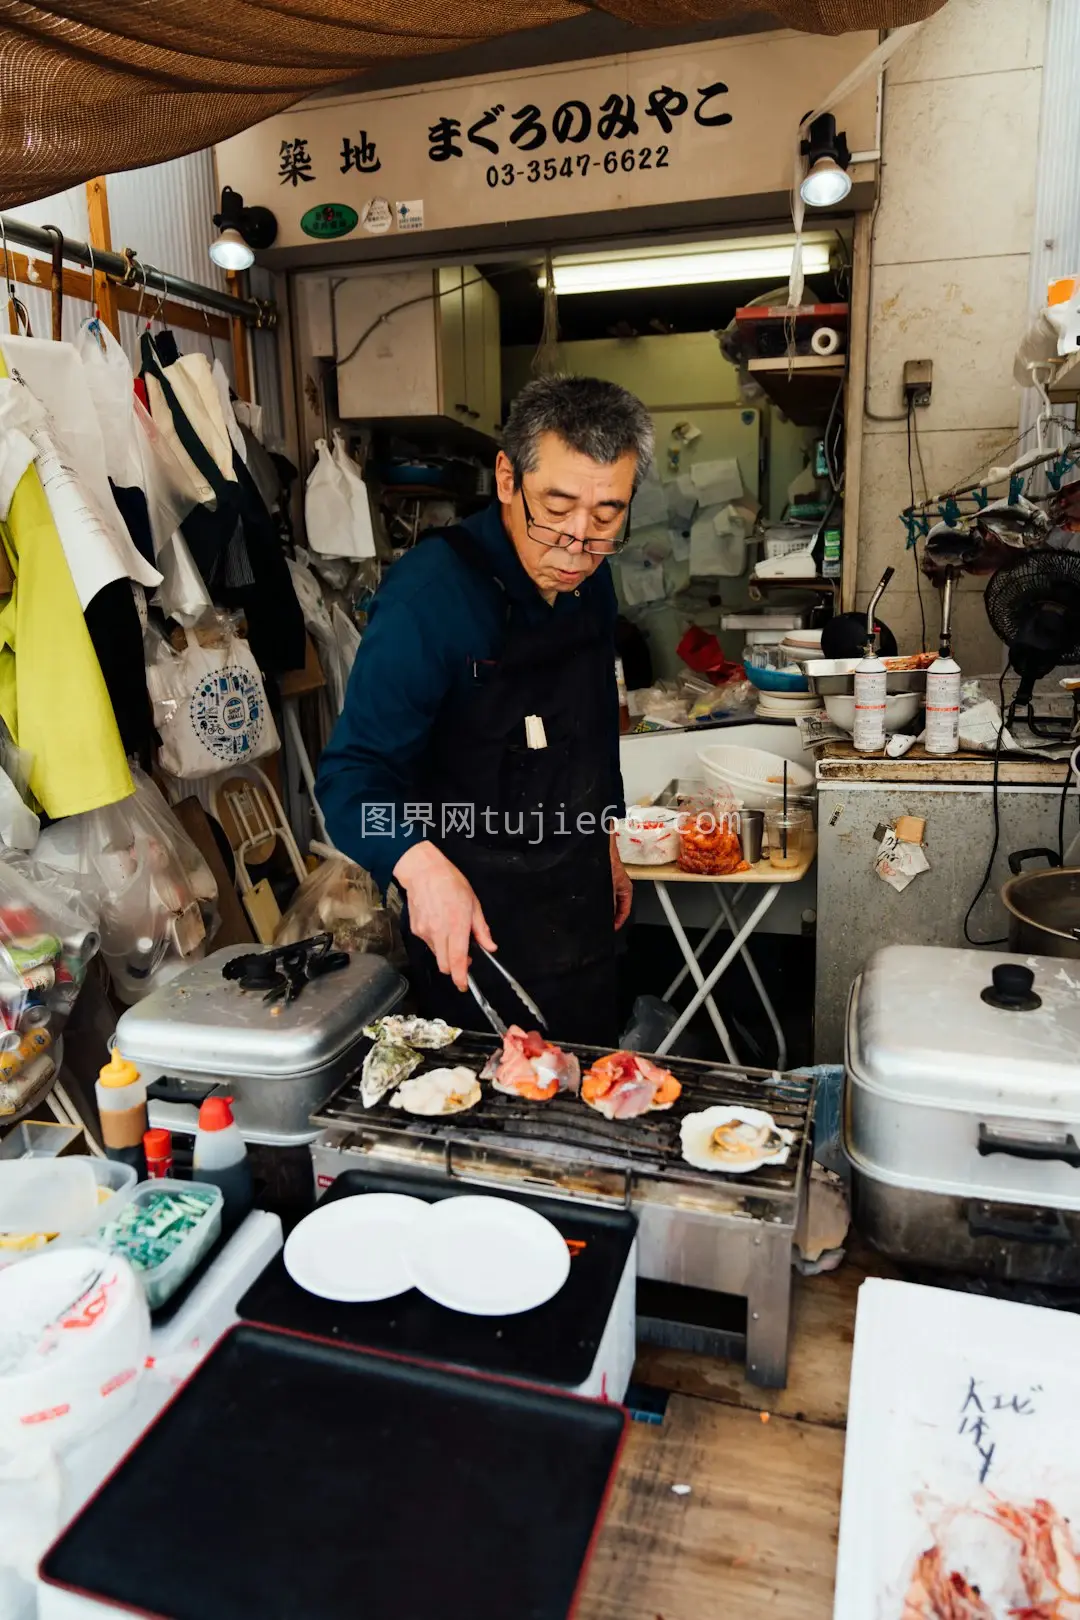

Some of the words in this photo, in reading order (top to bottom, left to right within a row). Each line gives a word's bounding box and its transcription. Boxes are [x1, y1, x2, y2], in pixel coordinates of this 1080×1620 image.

[278, 130, 381, 187] 築地
[428, 82, 732, 162] まぐろのみやこ
[486, 145, 669, 188] 03-3547-6622
